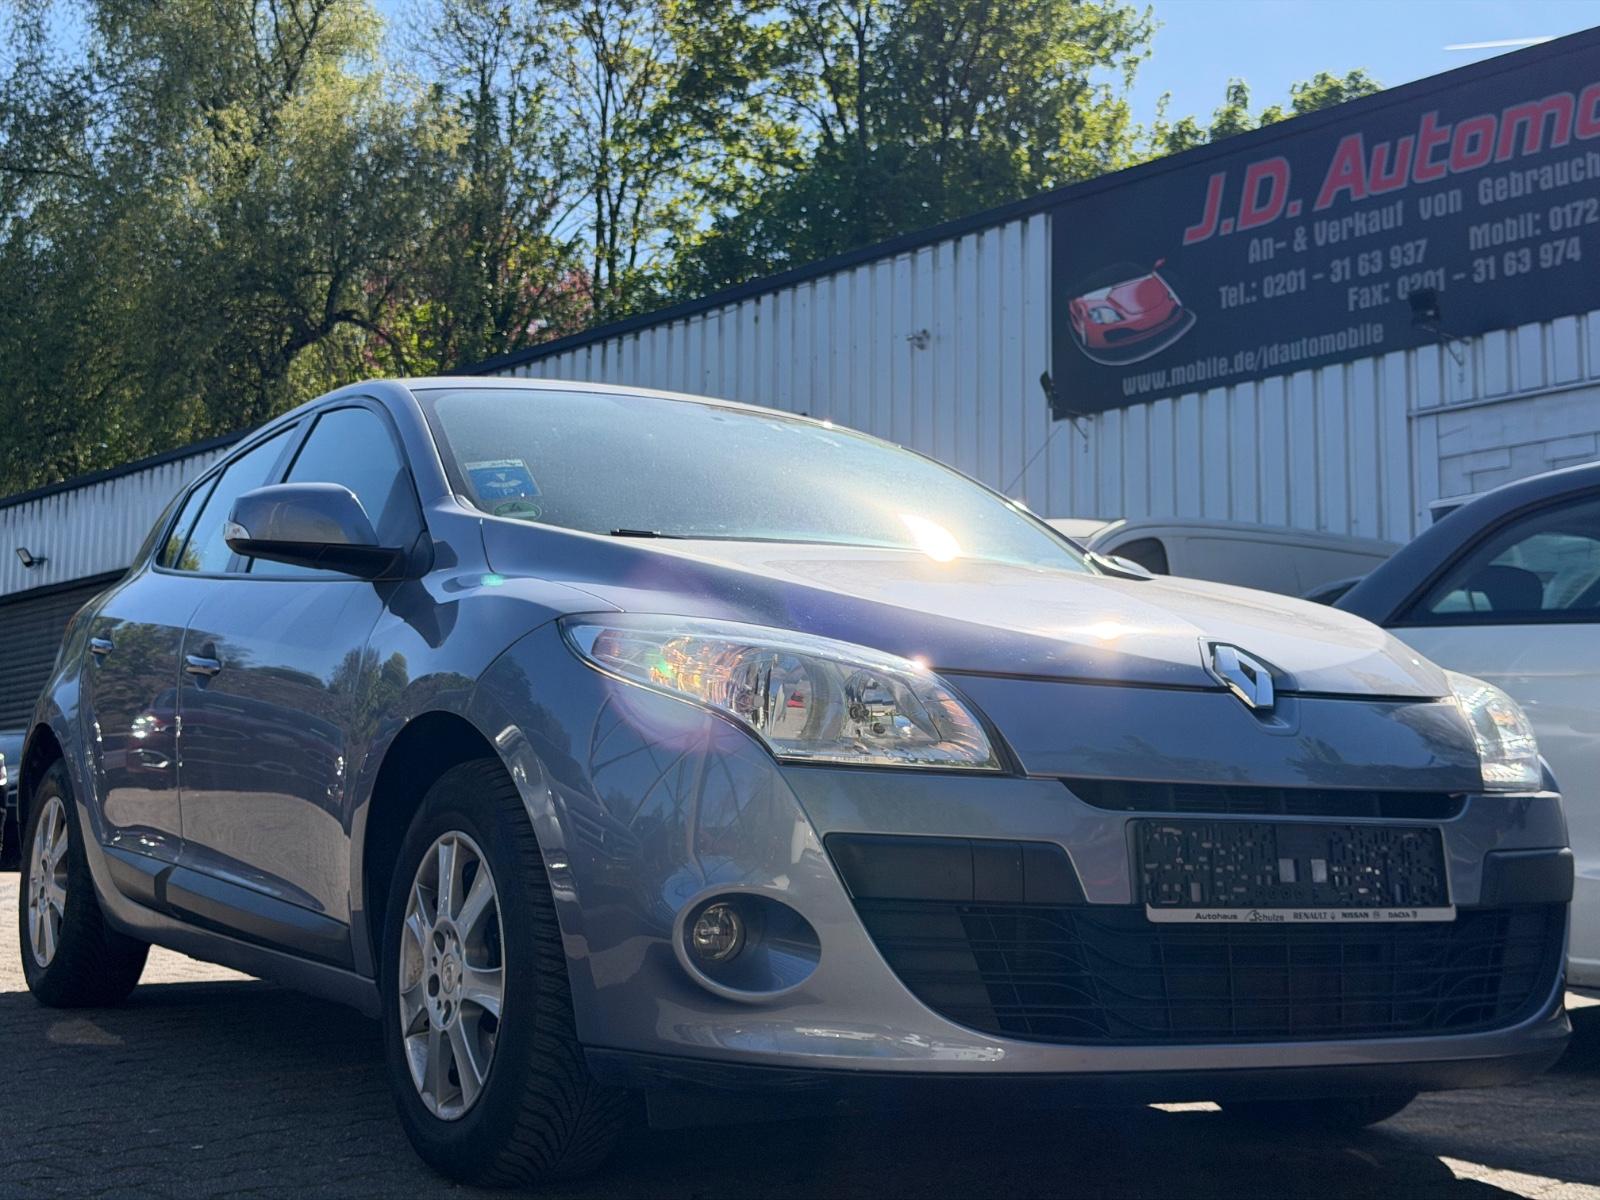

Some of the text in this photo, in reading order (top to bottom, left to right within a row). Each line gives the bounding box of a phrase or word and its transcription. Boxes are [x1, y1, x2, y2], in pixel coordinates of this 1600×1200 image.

[1183, 156, 1302, 246] J.D.
[1248, 237, 1287, 264] An-
[1293, 226, 1308, 252] &
[1313, 201, 1404, 247] Verkauf
[1418, 189, 1462, 220] von
[1219, 281, 1257, 309] Tel.:
[1263, 268, 1306, 299] 0201
[1330, 257, 1351, 283] 31
[1357, 250, 1382, 277] 63
[1390, 238, 1428, 269] 937
[1468, 212, 1541, 251] Mobil:
[1549, 198, 1600, 232] 0172
[1348, 282, 1390, 312] Fax:
[1397, 267, 1445, 300] 0201
[1472, 255, 1496, 283] 31
[1503, 248, 1531, 276] 63
[1539, 236, 1582, 268] 974
[1122, 322, 1384, 397] www.mobile.de/jdautomobile
[1195, 912, 1238, 920] Autohaus
[1293, 911, 1328, 920] RENAULT
[1341, 911, 1369, 919] NISSAN
